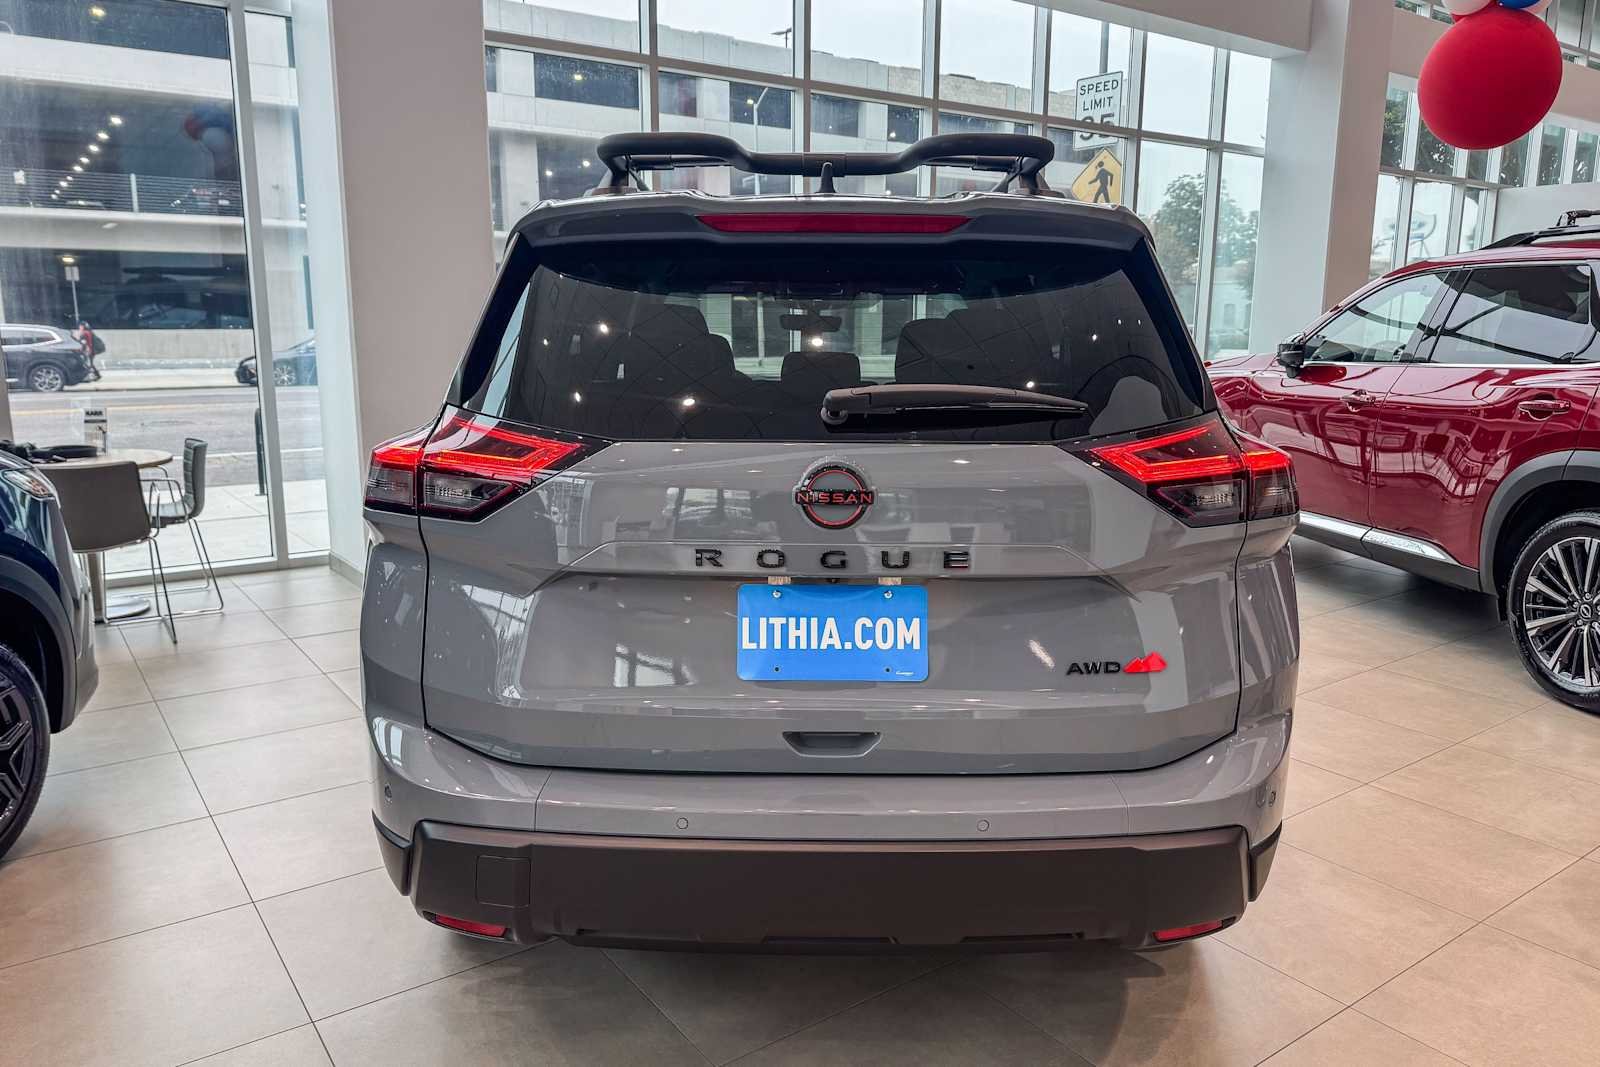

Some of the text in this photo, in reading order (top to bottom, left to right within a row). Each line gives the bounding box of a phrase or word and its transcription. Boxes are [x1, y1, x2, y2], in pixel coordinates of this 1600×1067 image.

[1079, 80, 1119, 96] SPEED
[1083, 97, 1113, 111] LIMIT
[797, 493, 873, 504] NISSAN
[695, 549, 970, 569] ROGUE
[741, 617, 921, 650] LITHIA.COM
[1066, 661, 1121, 675] AWD
